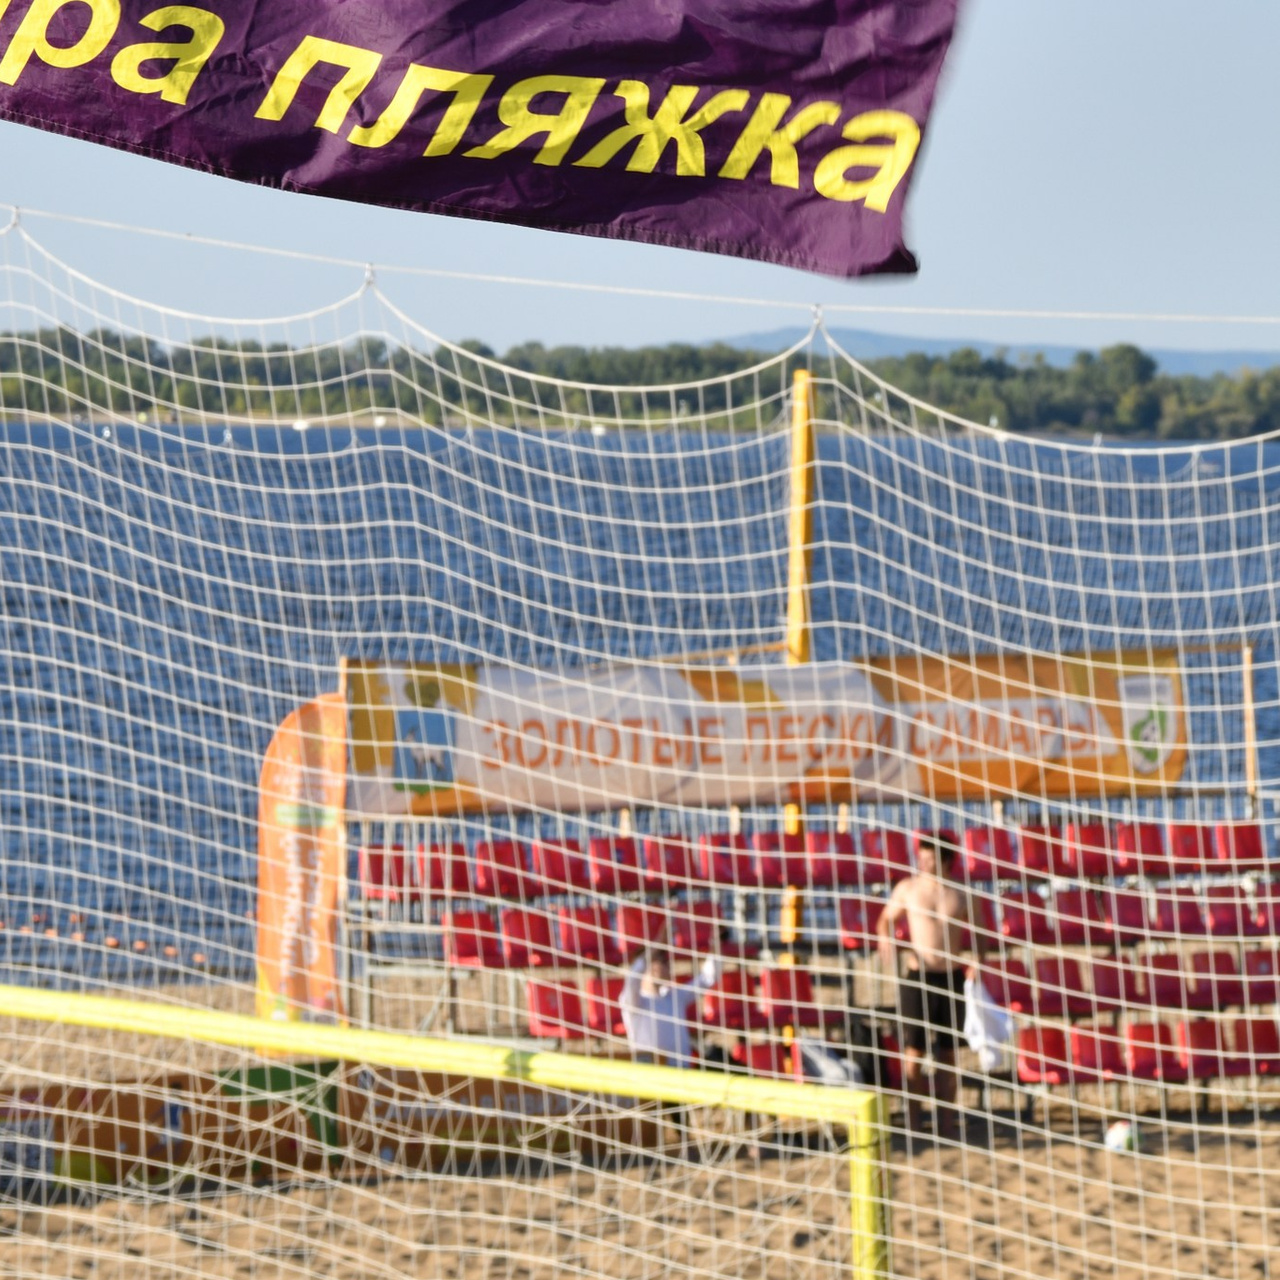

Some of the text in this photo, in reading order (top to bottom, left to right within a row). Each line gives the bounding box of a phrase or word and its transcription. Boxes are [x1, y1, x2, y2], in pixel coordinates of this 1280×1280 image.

[254, 35, 921, 214] пляжка
[480, 703, 1099, 770] ЗОЛОТЫЕ ПЕСКИ САМАРЫ
